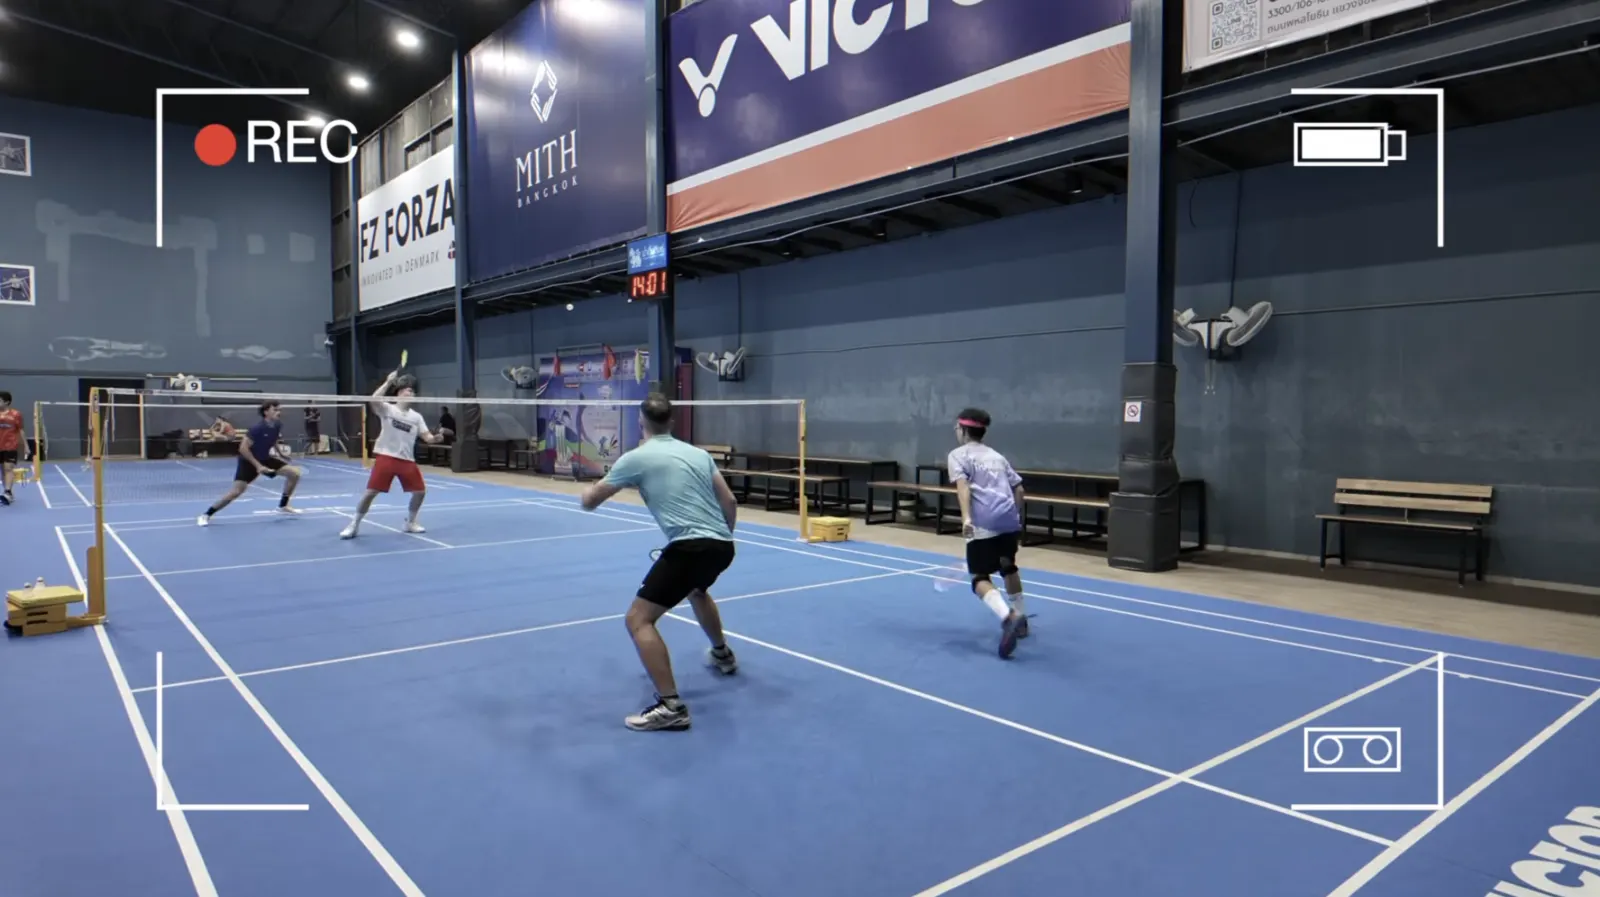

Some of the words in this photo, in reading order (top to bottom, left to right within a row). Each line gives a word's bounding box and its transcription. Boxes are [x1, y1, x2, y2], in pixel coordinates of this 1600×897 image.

[750, 0, 986, 81] VIC
[516, 129, 577, 192] MITH
[517, 175, 577, 208] BANGKOK
[360, 216, 379, 263] FZ
[385, 178, 456, 253] FORZA
[395, 263, 403, 275] IN
[404, 249, 440, 273] DENMARK
[190, 382, 199, 391] 9
[1484, 805, 1600, 897] CTO
